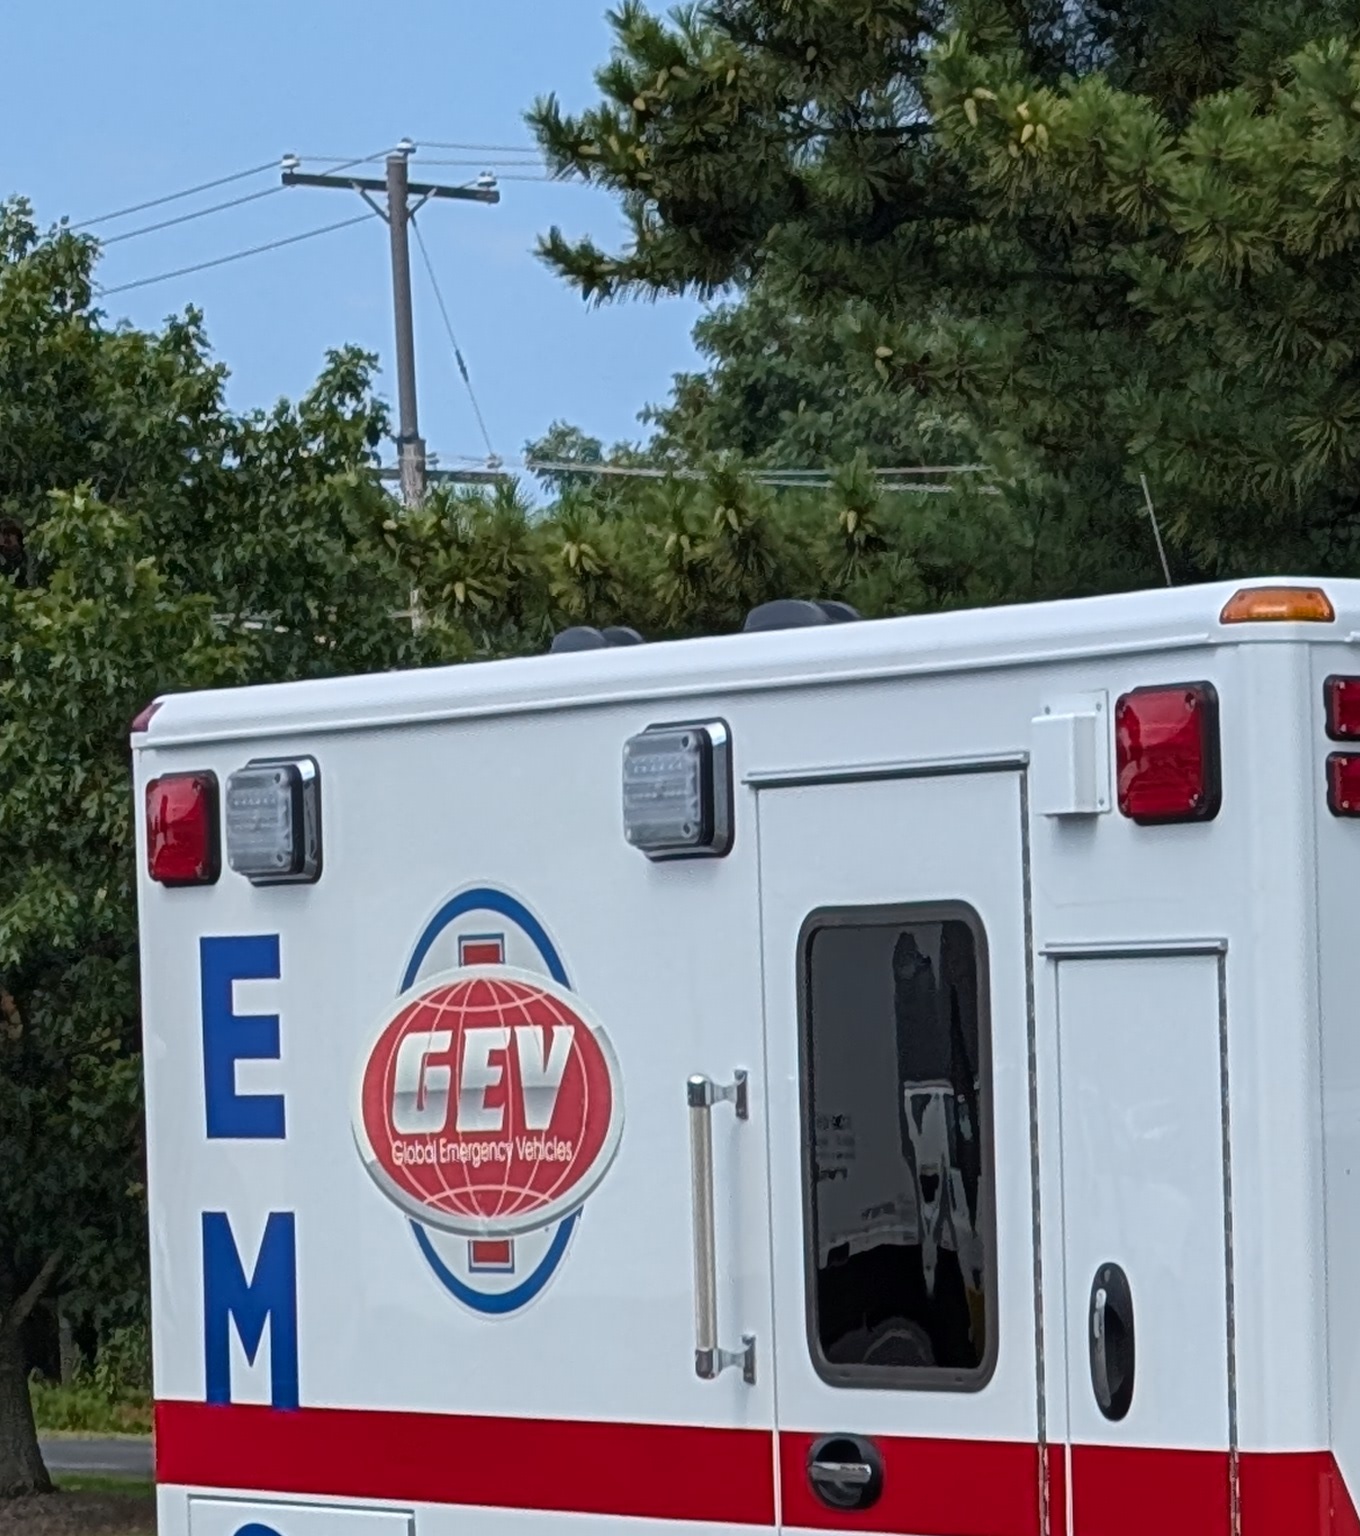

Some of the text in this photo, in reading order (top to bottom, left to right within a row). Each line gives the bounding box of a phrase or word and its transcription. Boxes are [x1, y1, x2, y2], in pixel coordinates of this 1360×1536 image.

[392, 1025, 575, 1135] GEV
[391, 1135, 573, 1168] Global Emergency Vehicles
